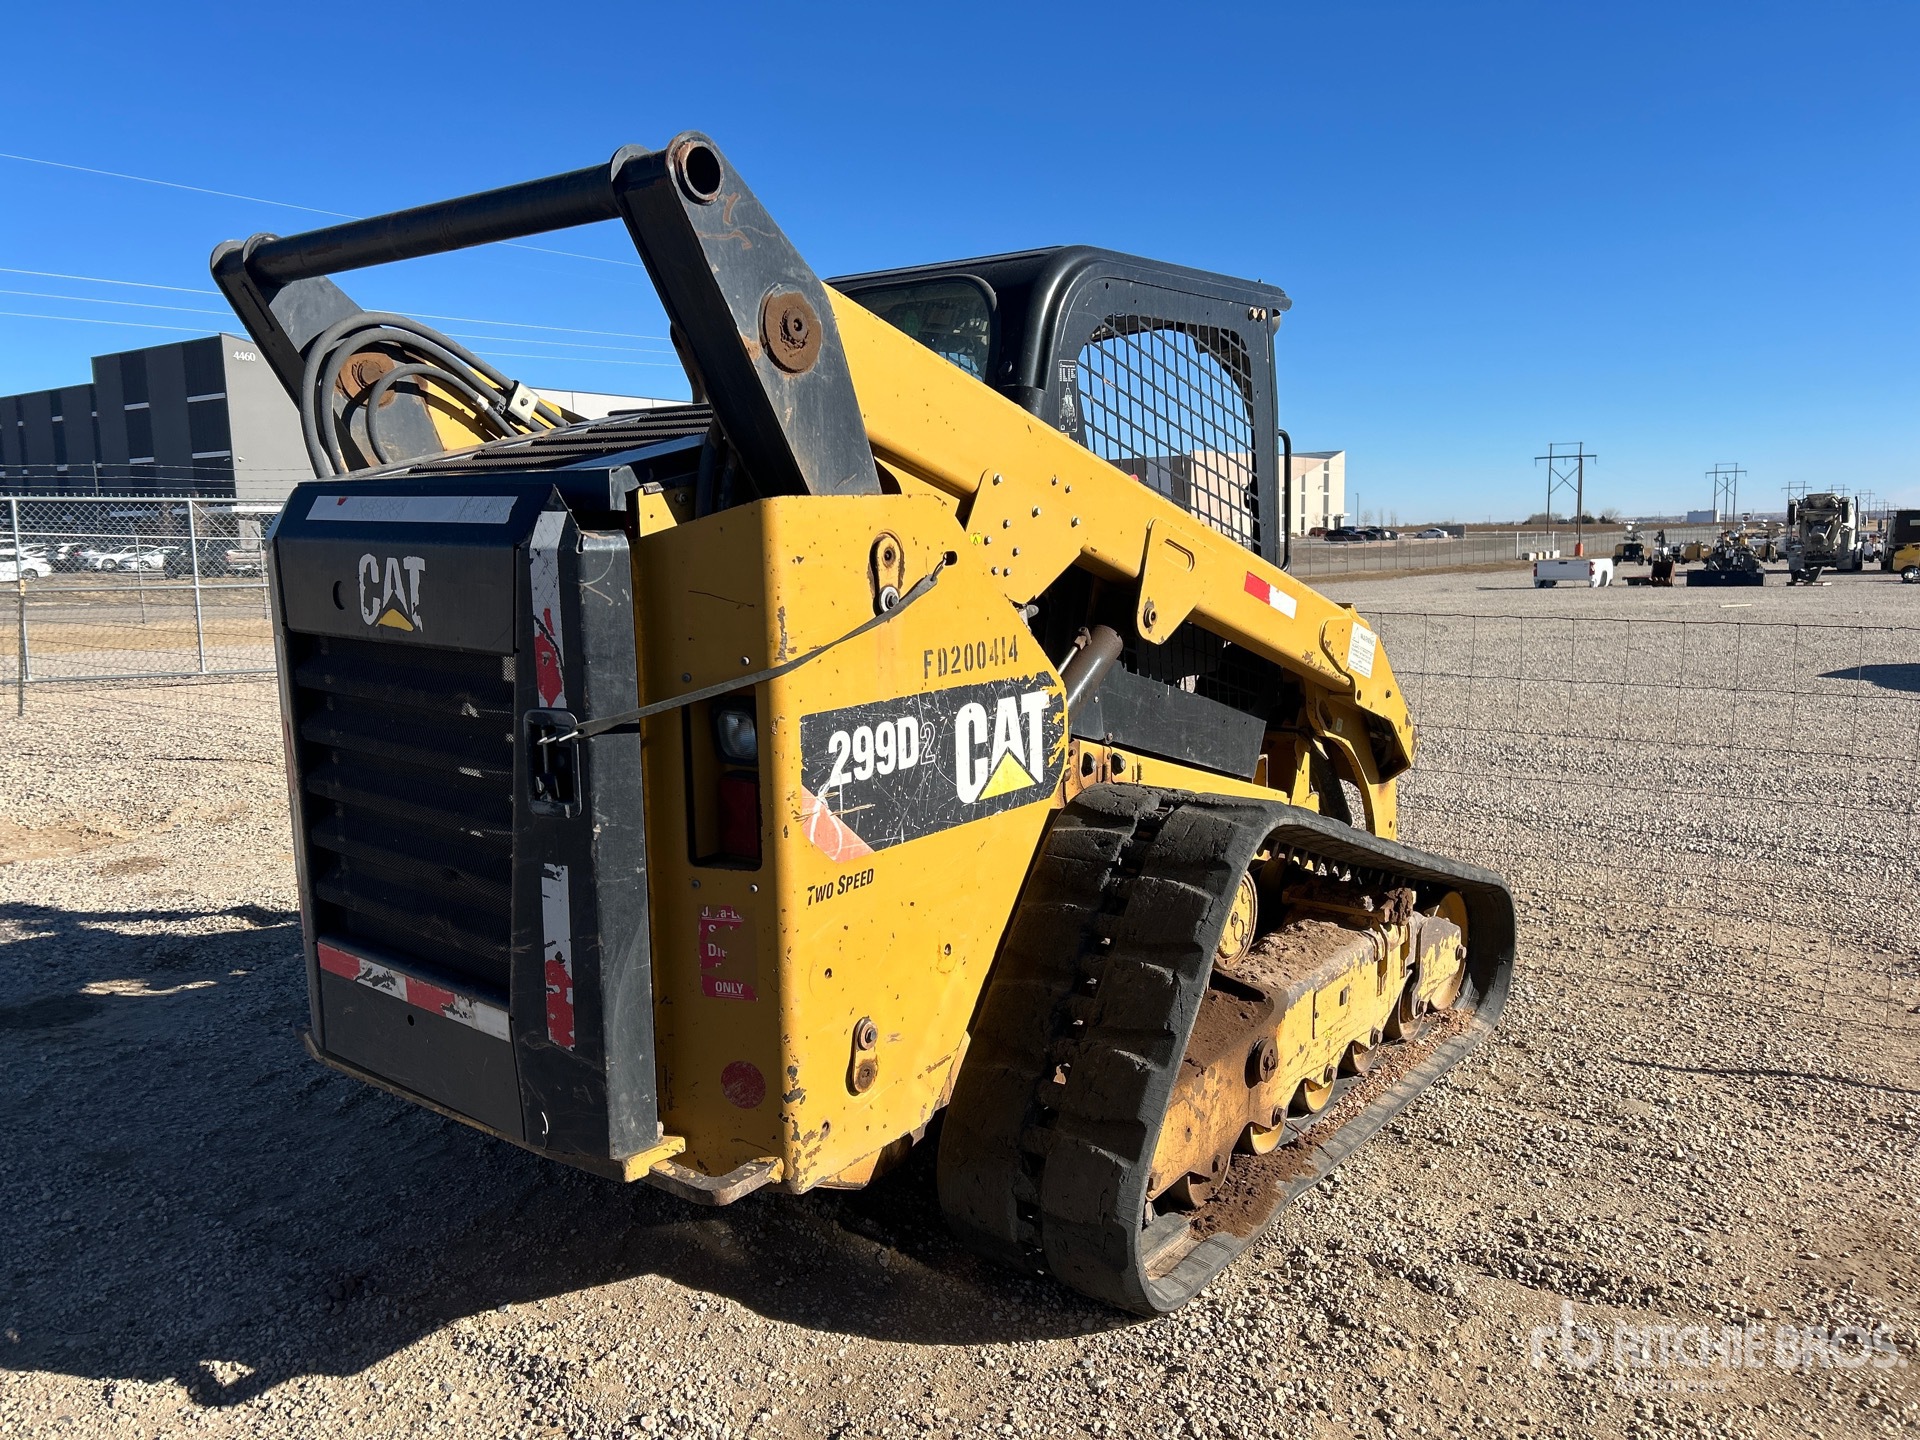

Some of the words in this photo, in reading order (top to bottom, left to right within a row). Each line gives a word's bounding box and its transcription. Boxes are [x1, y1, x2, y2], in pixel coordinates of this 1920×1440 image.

[233, 351, 256, 361] 4460
[358, 553, 426, 632] CAT
[828, 716, 936, 788] 299D2
[954, 689, 1050, 804] CAT
[715, 981, 744, 994] ONLY
